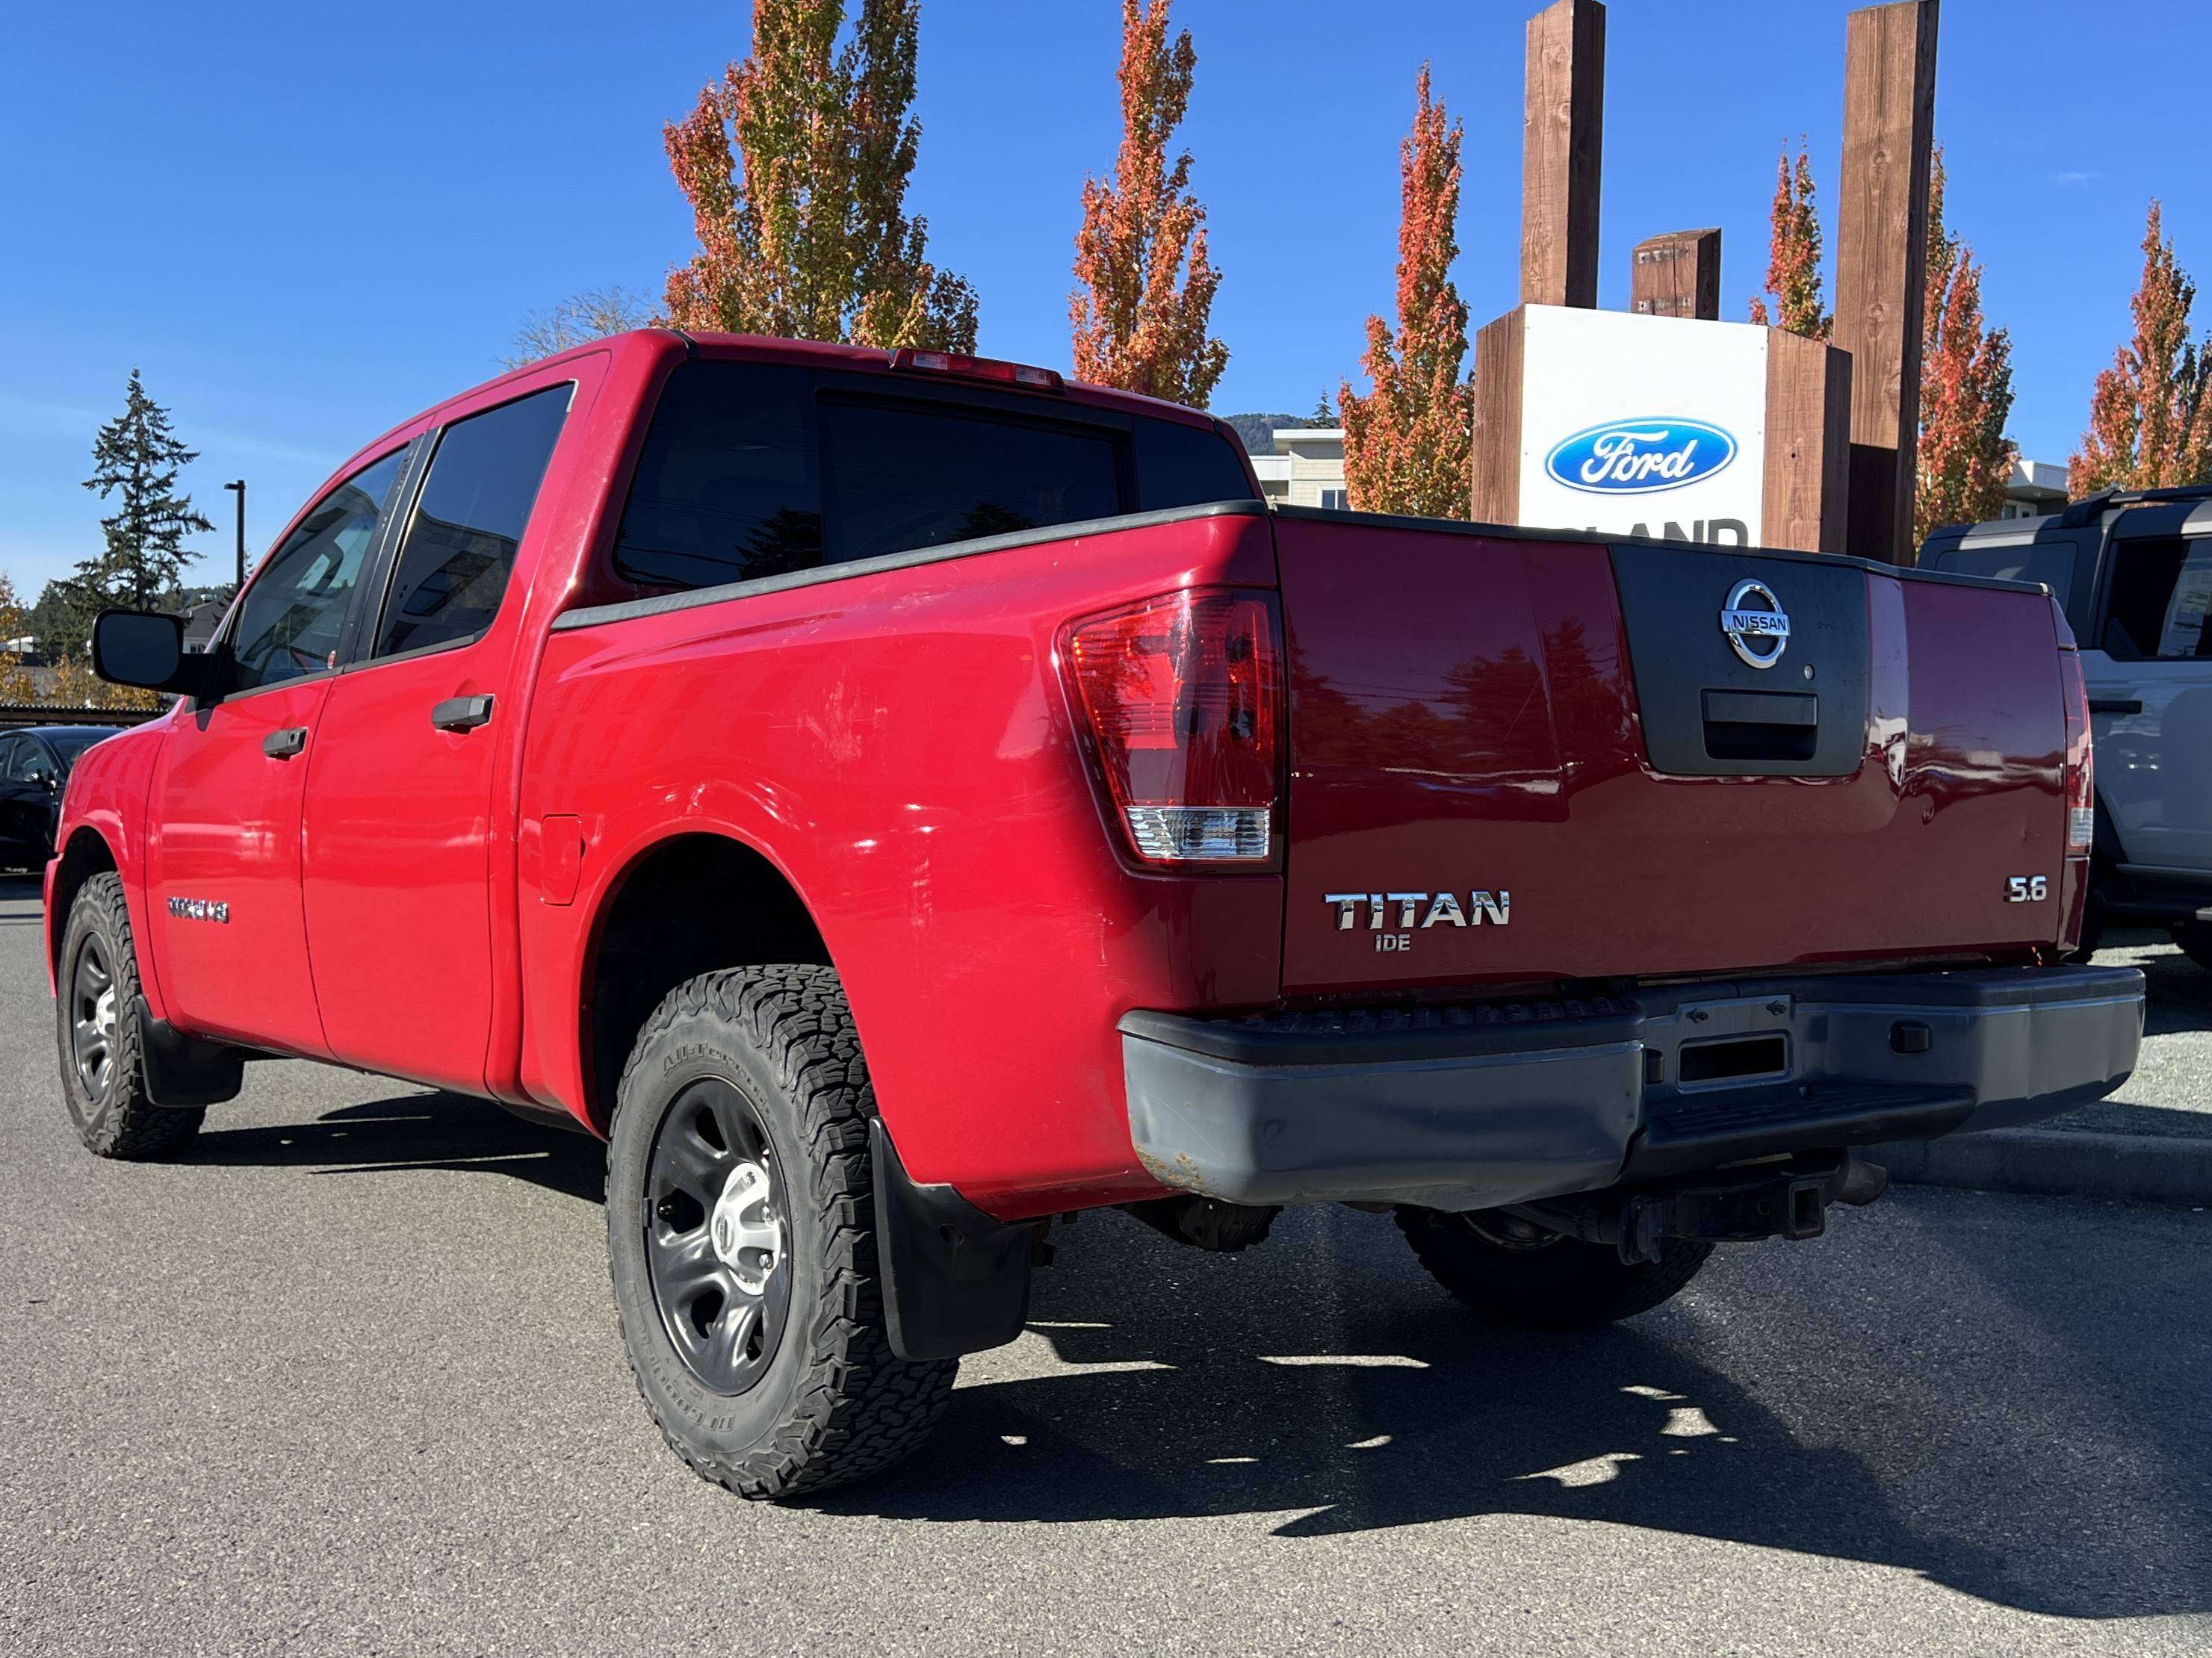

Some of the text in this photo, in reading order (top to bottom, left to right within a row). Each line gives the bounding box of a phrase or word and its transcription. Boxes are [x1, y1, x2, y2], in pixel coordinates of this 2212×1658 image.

[1581, 430, 1698, 483] Ford
[1732, 615, 1786, 631] NISSAN
[2007, 875, 2048, 903] 5.6
[1323, 890, 1510, 931] TITAN
